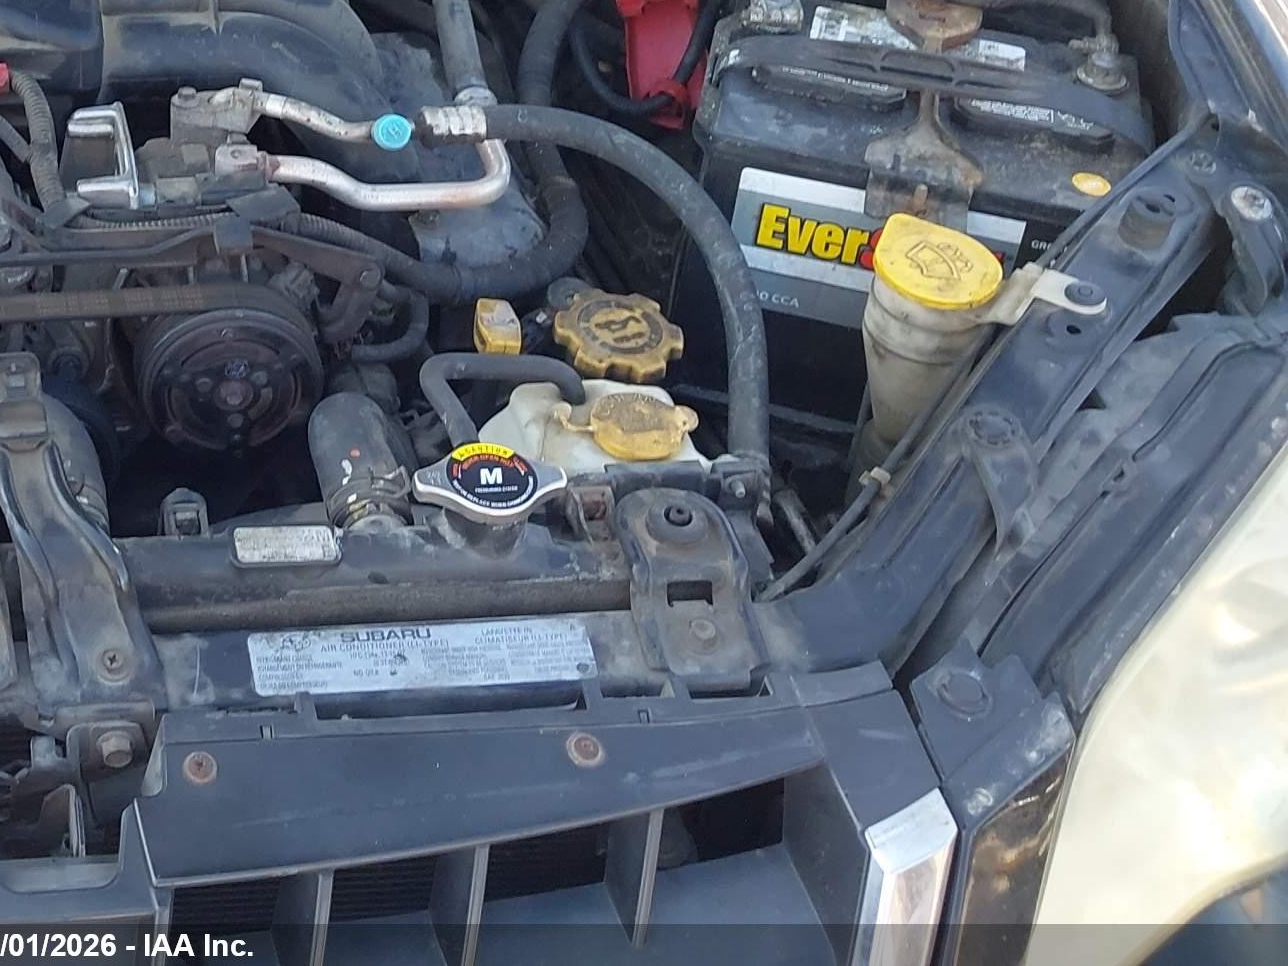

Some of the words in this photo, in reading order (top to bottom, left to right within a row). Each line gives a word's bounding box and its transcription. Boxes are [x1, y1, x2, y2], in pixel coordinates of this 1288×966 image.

[772, 294, 800, 309] CCA
[480, 467, 503, 485] M
[341, 627, 431, 643] SUBARU
